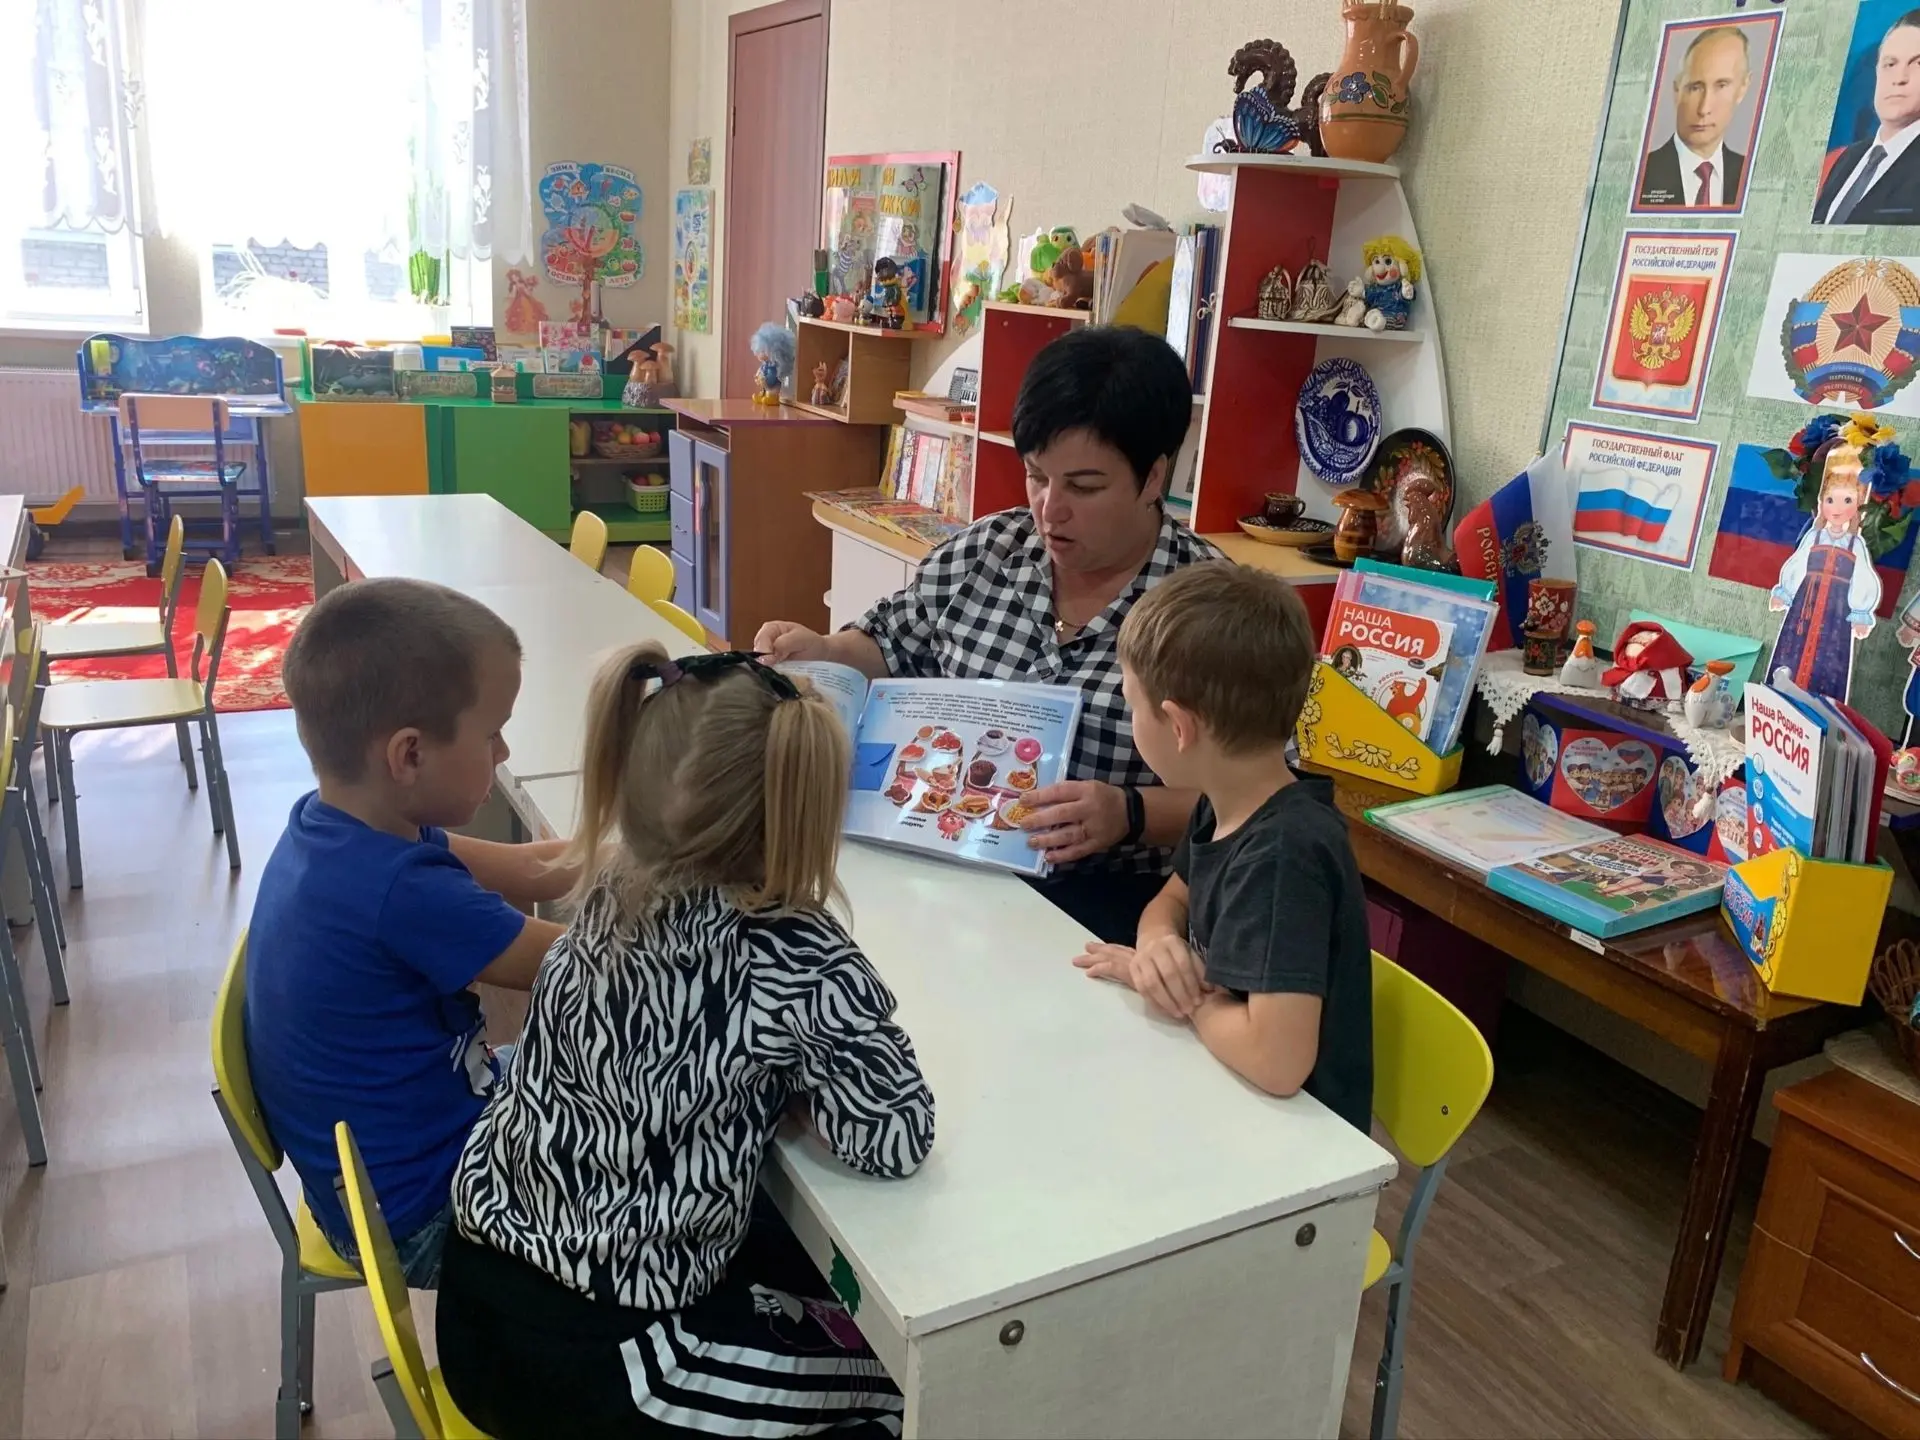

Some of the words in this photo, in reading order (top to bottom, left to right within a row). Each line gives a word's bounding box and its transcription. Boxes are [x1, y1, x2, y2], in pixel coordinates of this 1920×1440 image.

[605, 166, 632, 180] ВЕСНА
[1634, 244, 1701, 257] ГОСУДАРСТВЕННЫЙ
[1701, 246, 1719, 257] ГЕРБ
[1631, 256, 1675, 269] РОССИЙСКОЙ
[1675, 258, 1717, 271] ФЕДЕРАЦИИ
[1592, 438, 1662, 459] ГОСУДАРСТВЕННЫЙ
[1663, 450, 1685, 462] ФЛАГ
[1588, 452, 1636, 468] РОССИЙСКОЙ
[1636, 460, 1682, 477] ФЕДЕРАЦИИ
[1476, 527, 1500, 596] РОСС
[1343, 607, 1393, 629] НАША
[1339, 620, 1425, 656] РОССИЯ
[1751, 696, 1776, 720] Наша
[1776, 709, 1804, 740] Родина
[1752, 715, 1810, 776] РОССИЯ
